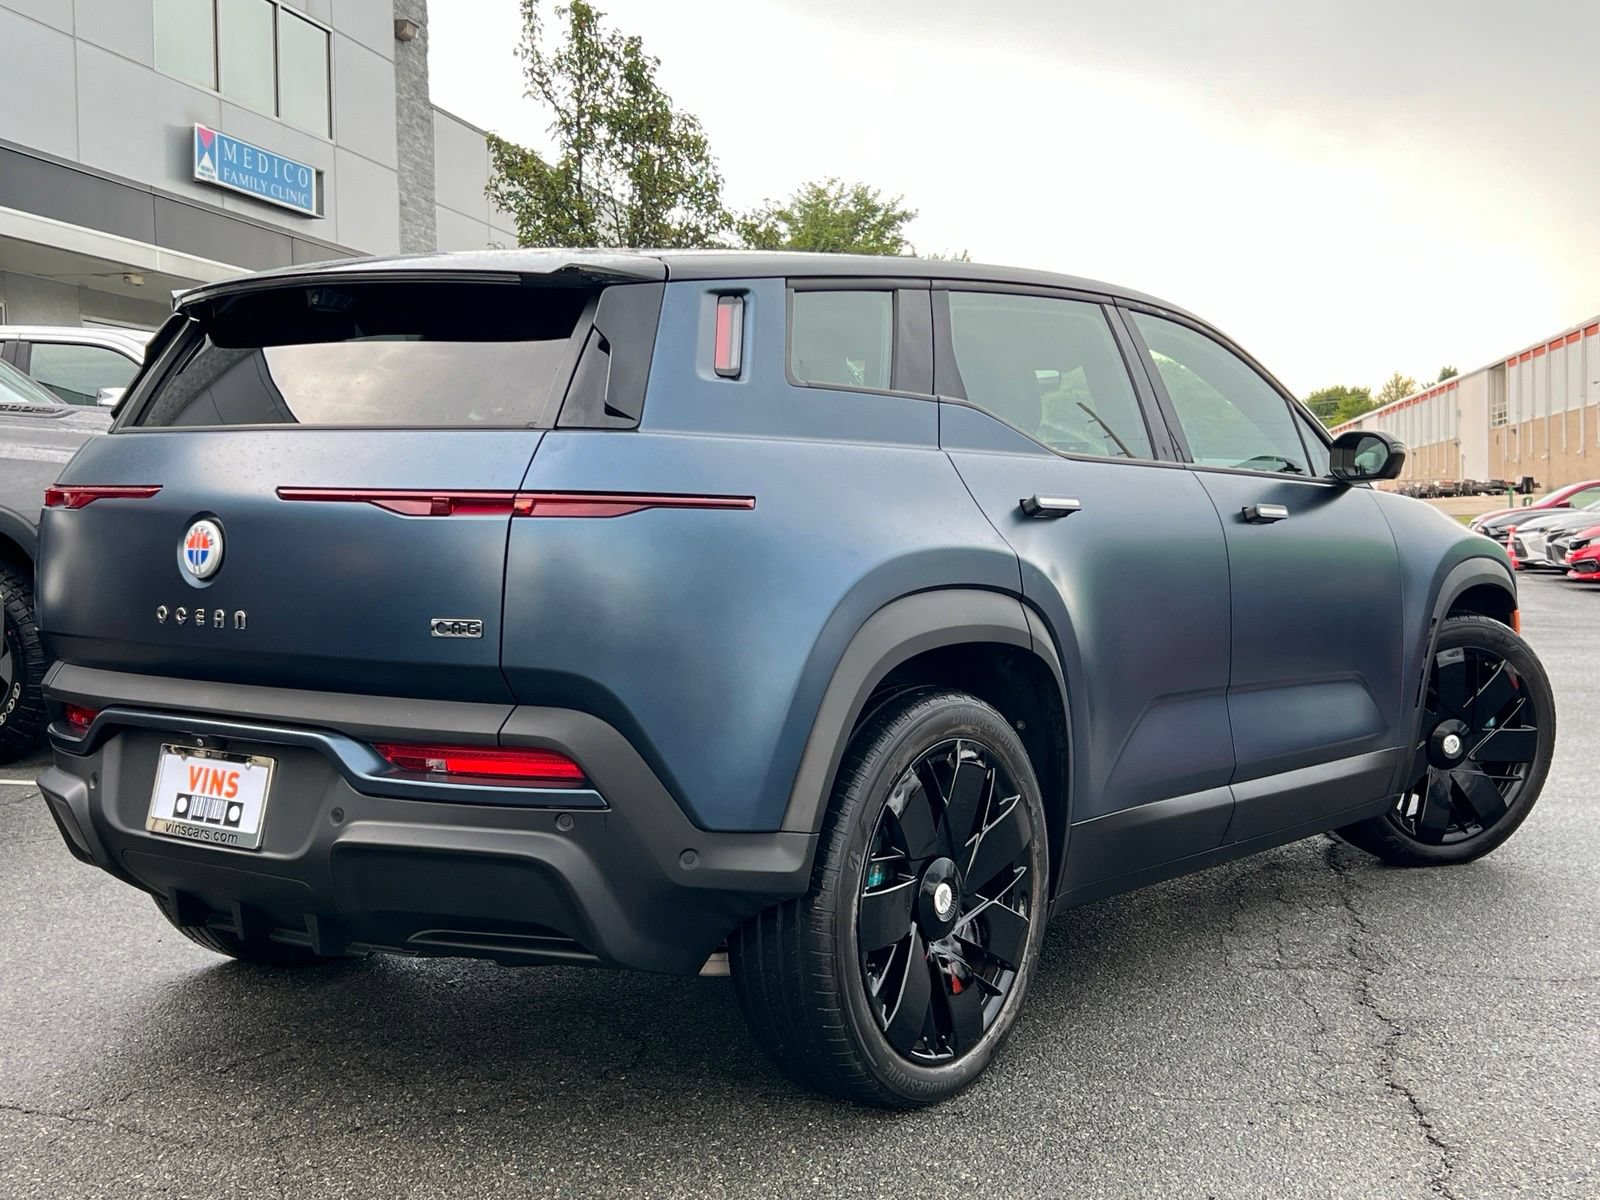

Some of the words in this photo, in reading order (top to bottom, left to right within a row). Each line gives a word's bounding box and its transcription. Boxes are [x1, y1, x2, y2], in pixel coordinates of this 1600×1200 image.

[223, 140, 309, 188] MEDICO
[224, 168, 267, 193] FAMILY
[270, 183, 309, 207] CLINIC
[156, 605, 246, 630] OCEAN
[189, 766, 240, 798] VINS
[165, 822, 238, 844] vinscars.com
